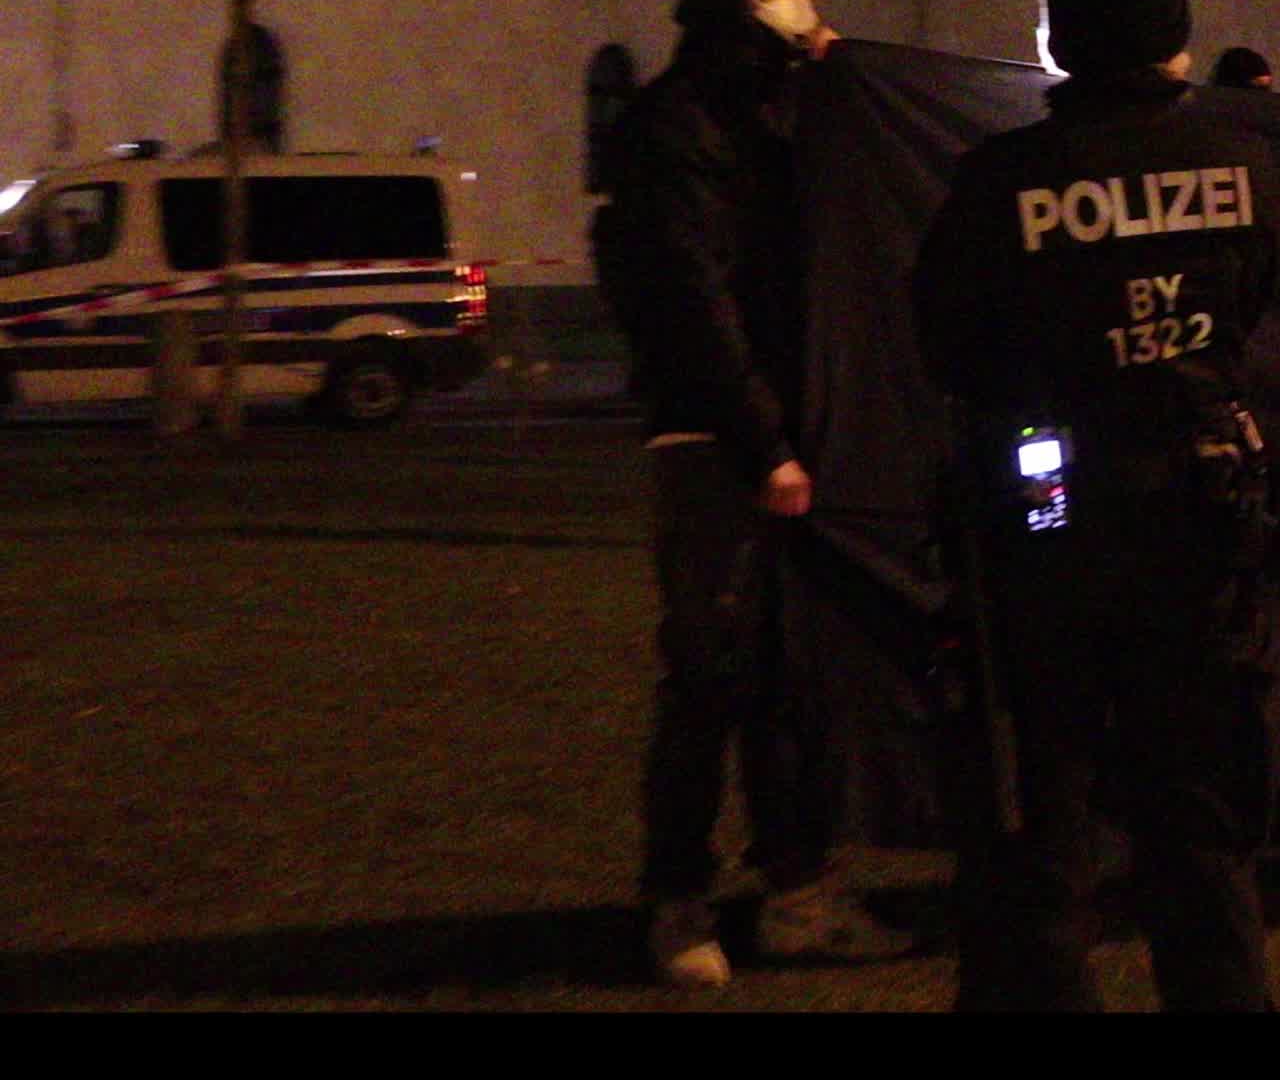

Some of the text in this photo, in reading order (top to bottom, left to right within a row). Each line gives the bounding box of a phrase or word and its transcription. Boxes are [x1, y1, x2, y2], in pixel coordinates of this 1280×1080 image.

[1016, 166, 1253, 251] POLIZEI
[1128, 274, 1184, 320] BY
[1105, 312, 1214, 367] 1322
